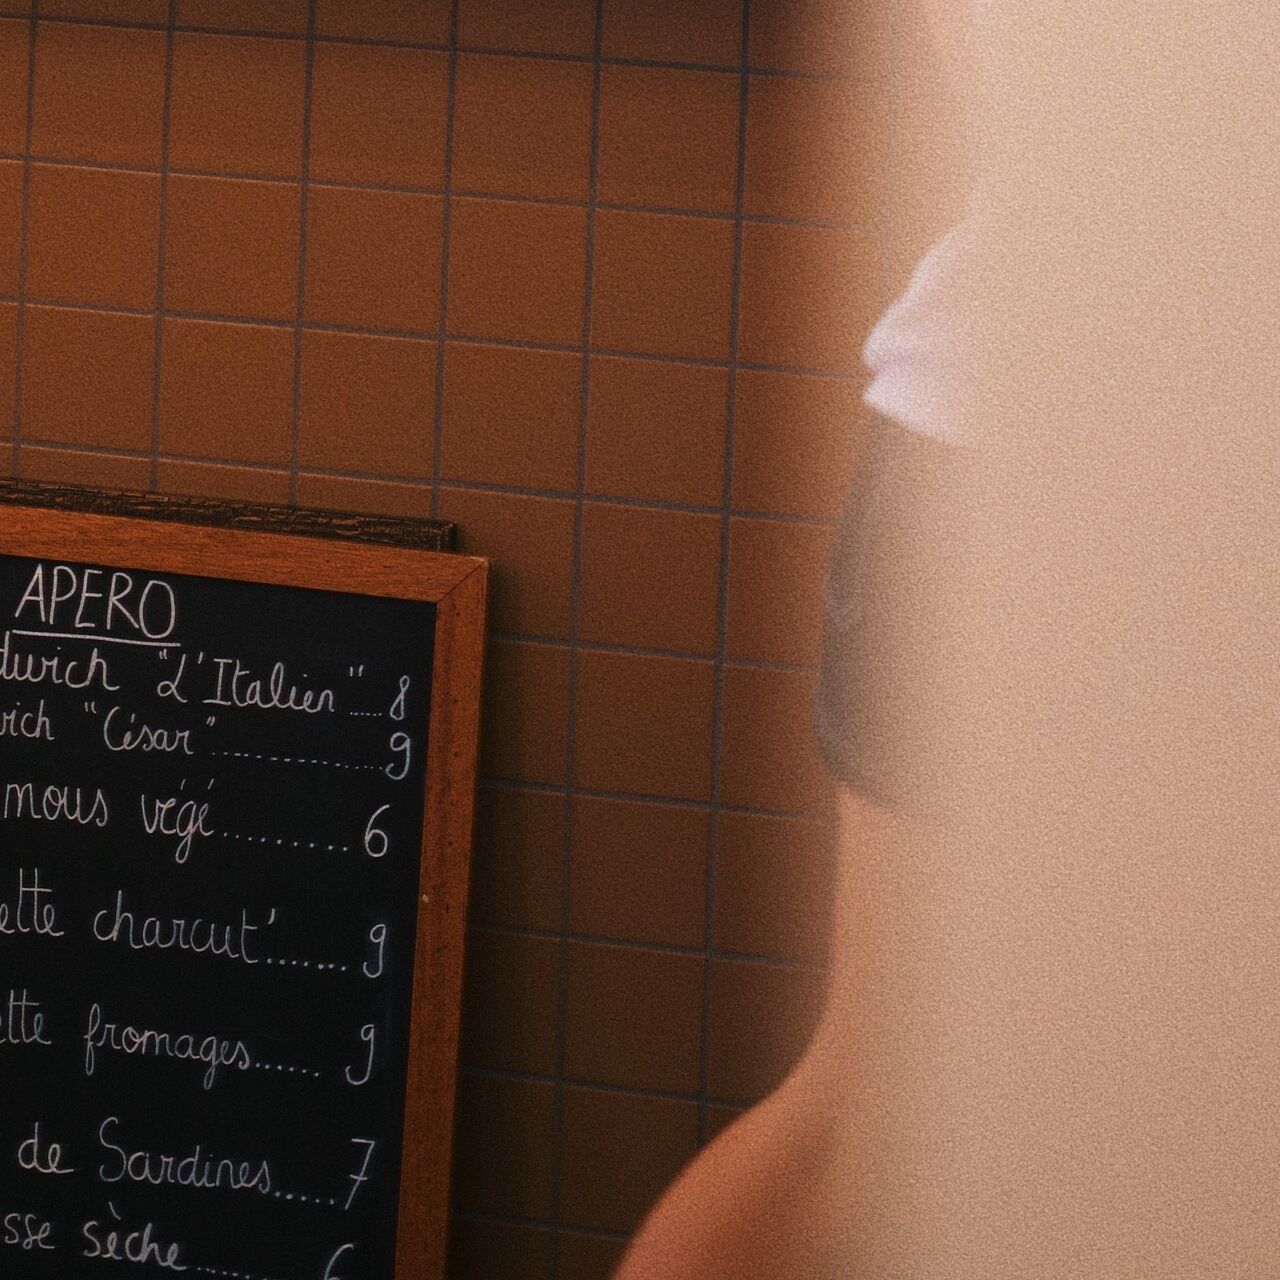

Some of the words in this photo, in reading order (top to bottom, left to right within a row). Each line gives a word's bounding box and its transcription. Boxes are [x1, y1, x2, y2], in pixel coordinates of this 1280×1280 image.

[14, 563, 177, 639] APERO
[389, 674, 410, 721] 8
[385, 731, 411, 781] 9
[140, 777, 215, 864] végé
[363, 804, 390, 858] 6
[362, 923, 387, 979] 9
[83, 1003, 251, 1090] fromages
[344, 1023, 375, 1086] 9
[17, 1122, 74, 1174] de
[98, 1116, 273, 1195] Sardines
[344, 1138, 376, 1210] 7
[83, 1202, 188, 1271] sèche
